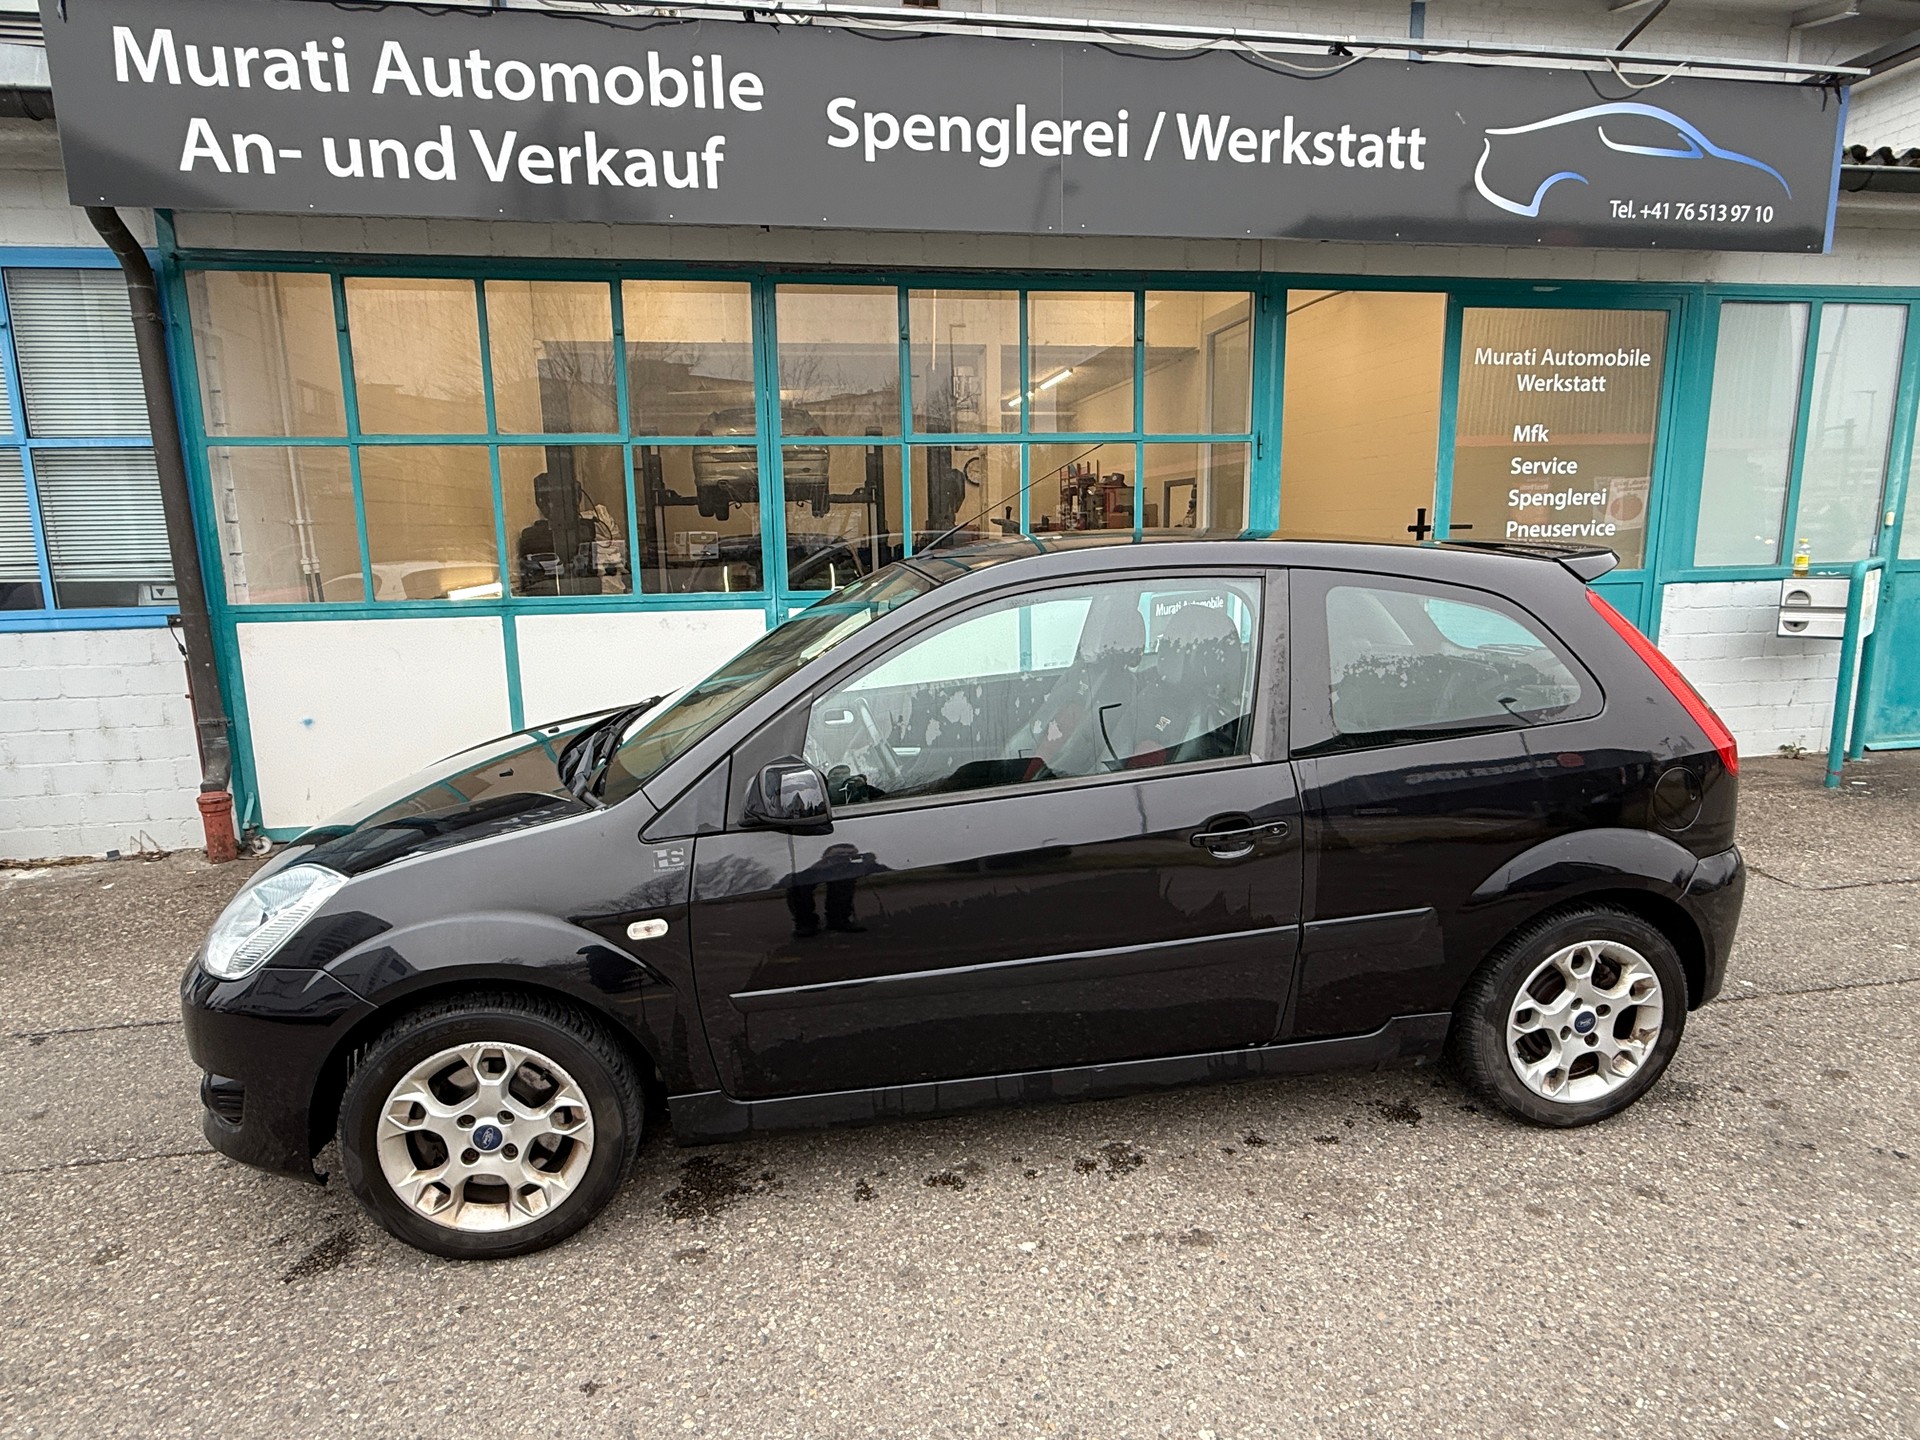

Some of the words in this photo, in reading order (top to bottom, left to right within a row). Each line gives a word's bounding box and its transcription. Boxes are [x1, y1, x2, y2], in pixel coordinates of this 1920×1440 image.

[112, 25, 350, 93] Murati
[371, 40, 764, 112] Automobile
[826, 97, 1129, 168] Spenglerei
[1143, 111, 1167, 161] /
[1176, 113, 1427, 171] Werkstatt
[179, 117, 302, 175] An-
[322, 124, 457, 181] und
[468, 129, 726, 189] Verkauf
[1609, 199, 1637, 219] Tel.
[1639, 202, 1670, 220] +41
[1674, 202, 1695, 221] 76
[1697, 203, 1728, 222] 513
[1730, 204, 1752, 223] 97
[1755, 205, 1774, 224] 10
[1474, 347, 1537, 366] Murati
[1540, 348, 1651, 367] Automobile
[1517, 373, 1607, 392] Werkstatt
[1513, 423, 1550, 443] Mfk
[1510, 456, 1578, 475] Service
[1508, 487, 1607, 511] Spenglerei
[1506, 519, 1616, 539] Pneuservice
[1155, 602, 1182, 617] Murati
[1183, 596, 1224, 609] Amobile
